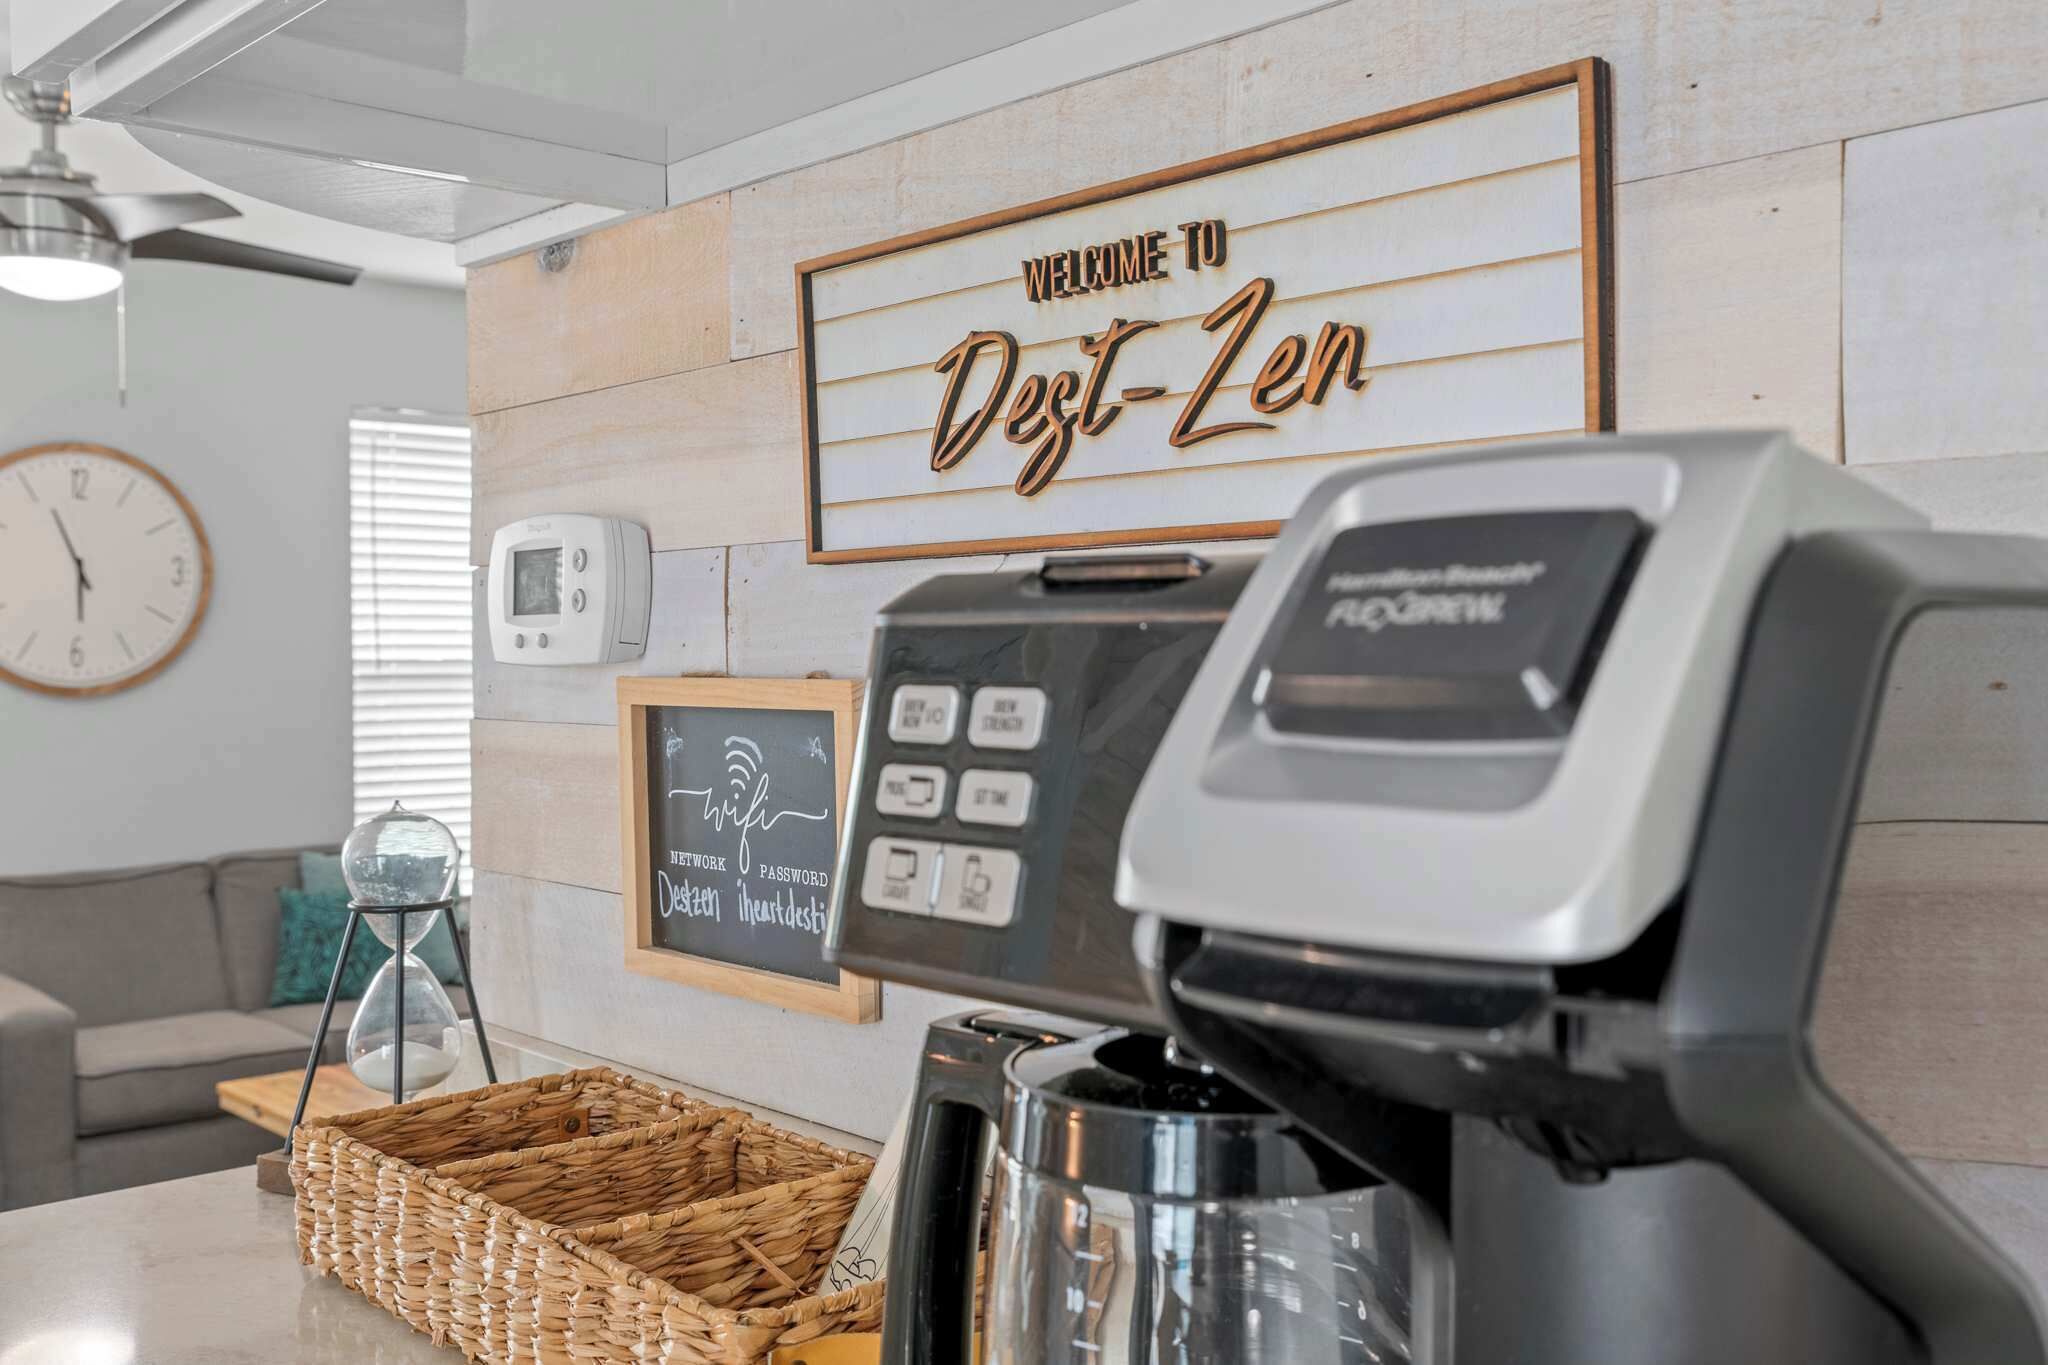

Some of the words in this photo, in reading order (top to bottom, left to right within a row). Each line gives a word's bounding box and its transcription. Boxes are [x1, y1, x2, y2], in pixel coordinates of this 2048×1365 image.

[1021, 230, 1168, 303] WELCOME
[1178, 219, 1227, 271] TO
[930, 277, 1367, 497] Dest-Zen
[71, 468, 88, 500] 12
[171, 557, 185, 586] 3
[70, 636, 84, 668] 6
[670, 850, 727, 872] NETWORK
[759, 863, 828, 888] PASSWORD
[657, 870, 721, 923] Destzen
[736, 878, 829, 934] iheartdesti
